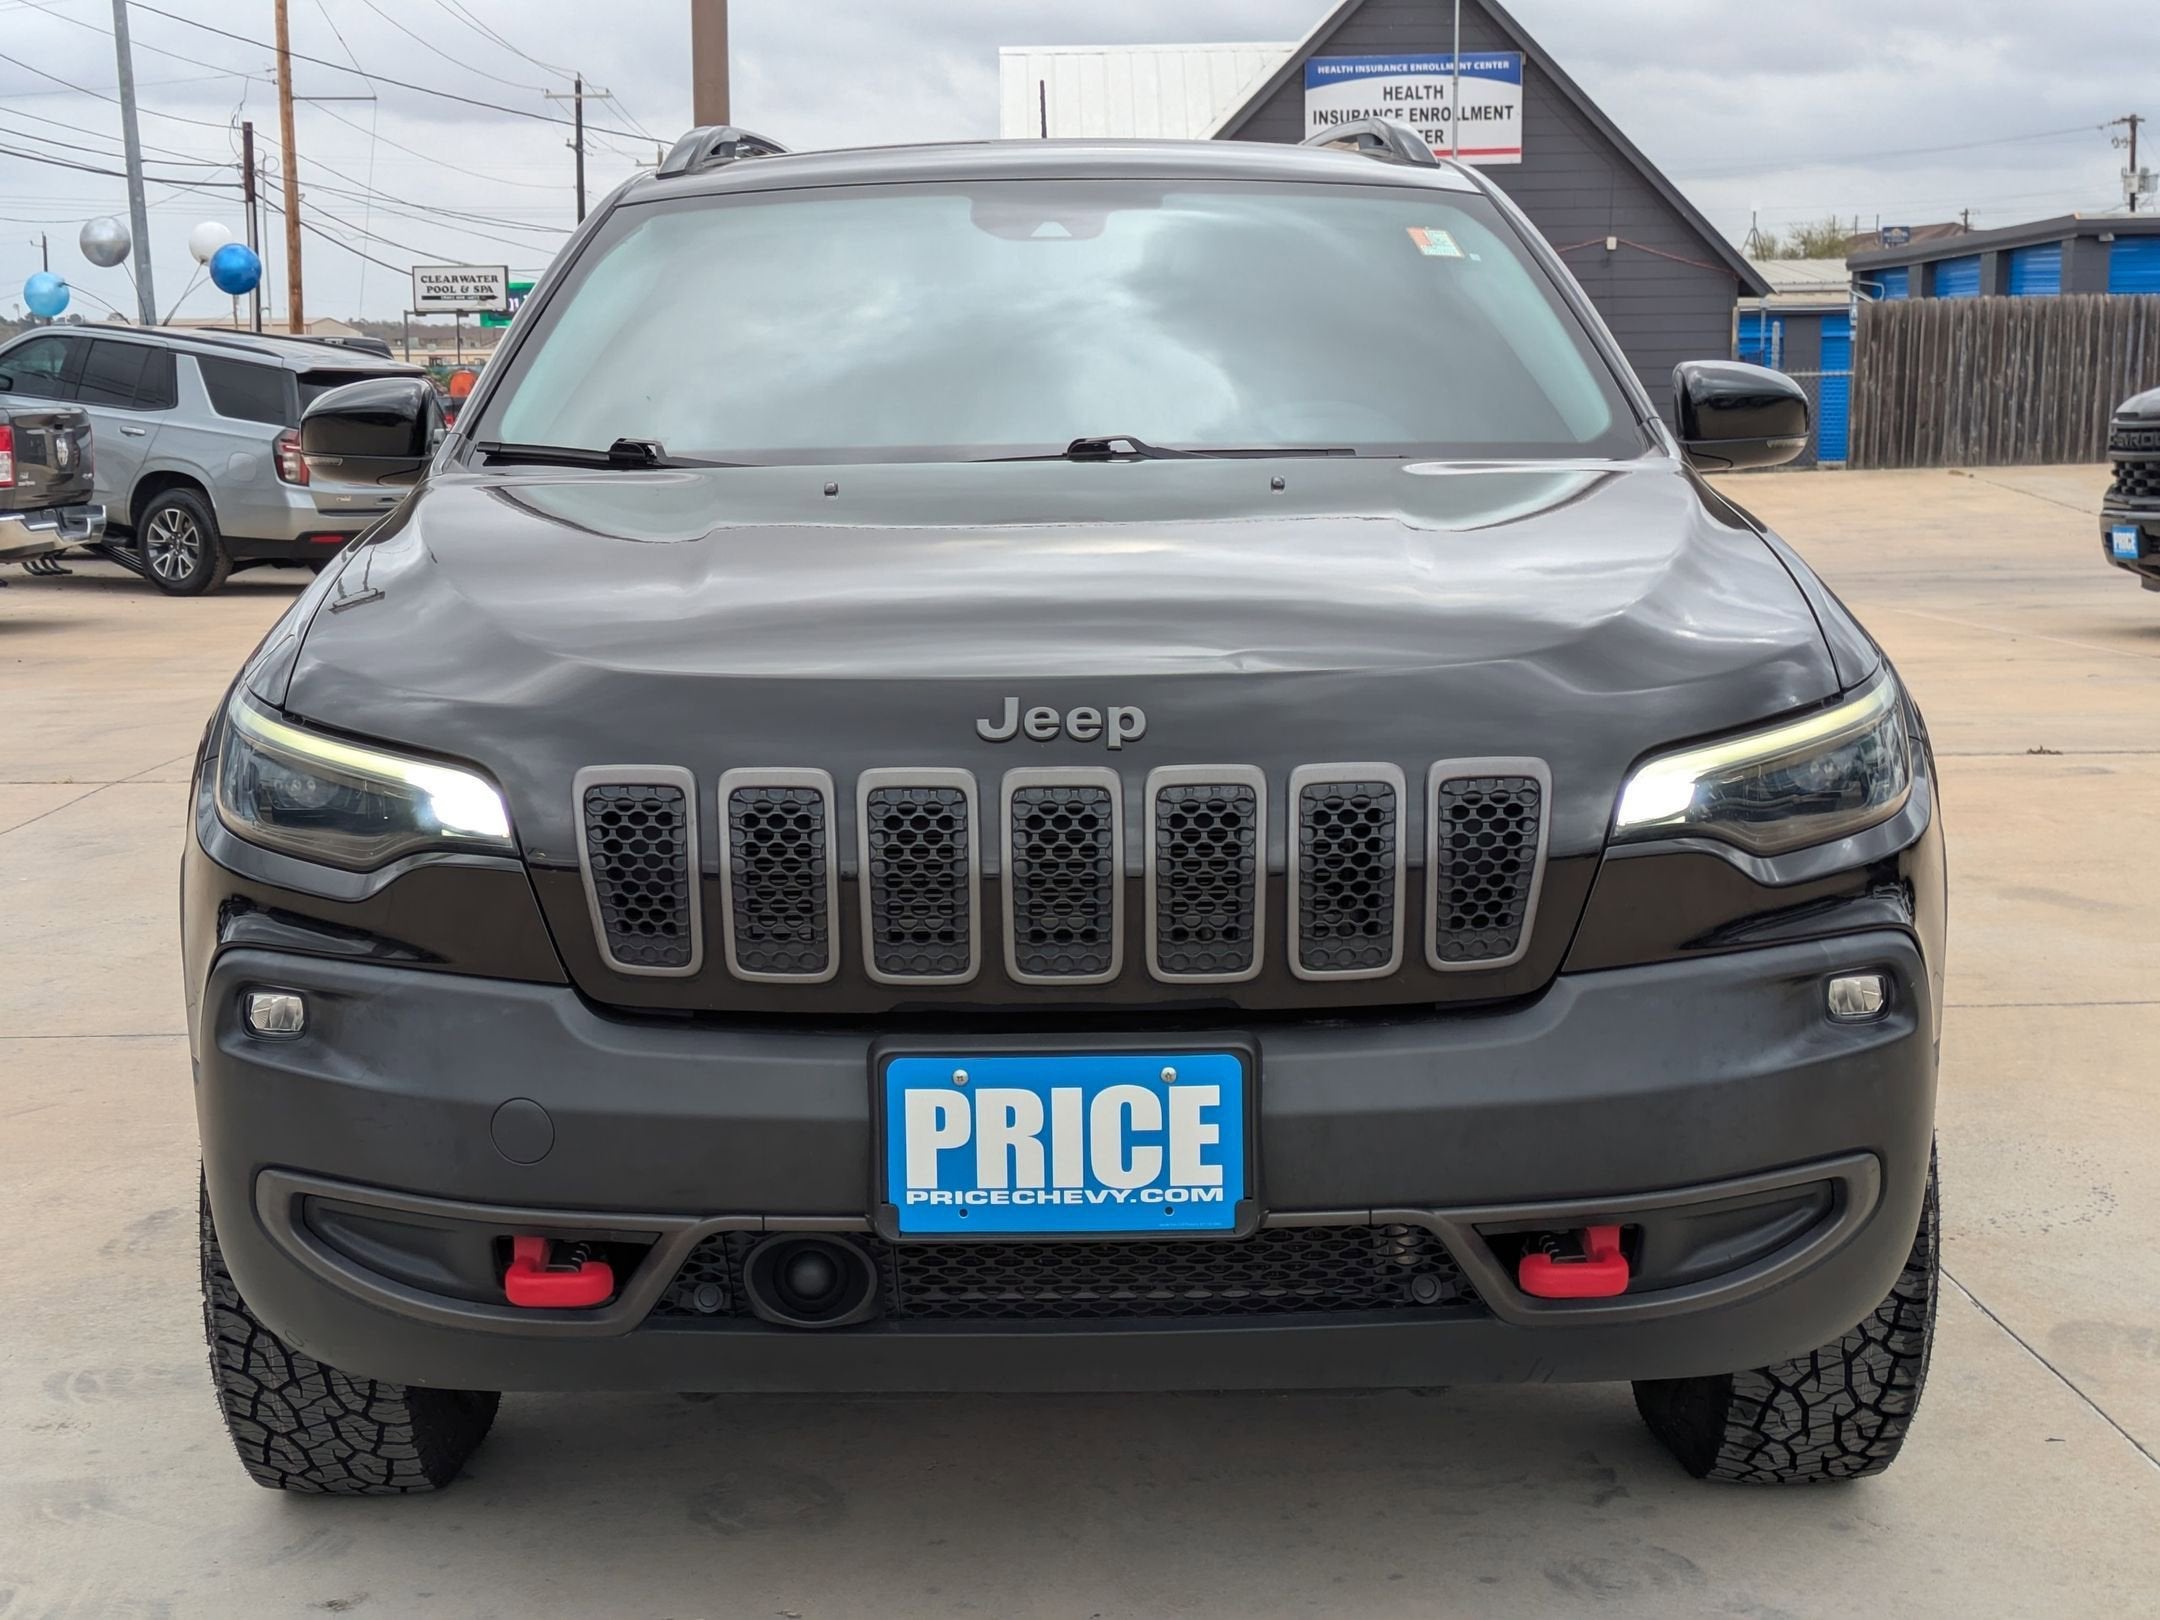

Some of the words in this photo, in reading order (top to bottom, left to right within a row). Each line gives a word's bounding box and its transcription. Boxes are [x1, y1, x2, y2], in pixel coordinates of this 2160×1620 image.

[1317, 65, 1353, 75] HEALTH
[1355, 63, 1408, 73] INSURANCE
[1410, 61, 1471, 72] ENROLLMNT
[1474, 60, 1510, 70] CENTER
[1383, 85, 1444, 101] HEALTH
[1409, 105, 1514, 122] ENROLMENT
[421, 275, 498, 283] CLEARWATER
[426, 285, 456, 293] POOL
[461, 285, 469, 293] &
[473, 285, 494, 293] SPA
[976, 696, 1147, 751] Jeep
[904, 1084, 1223, 1190] PRICE
[906, 1188, 1223, 1205] PRICECHEVY.COM
